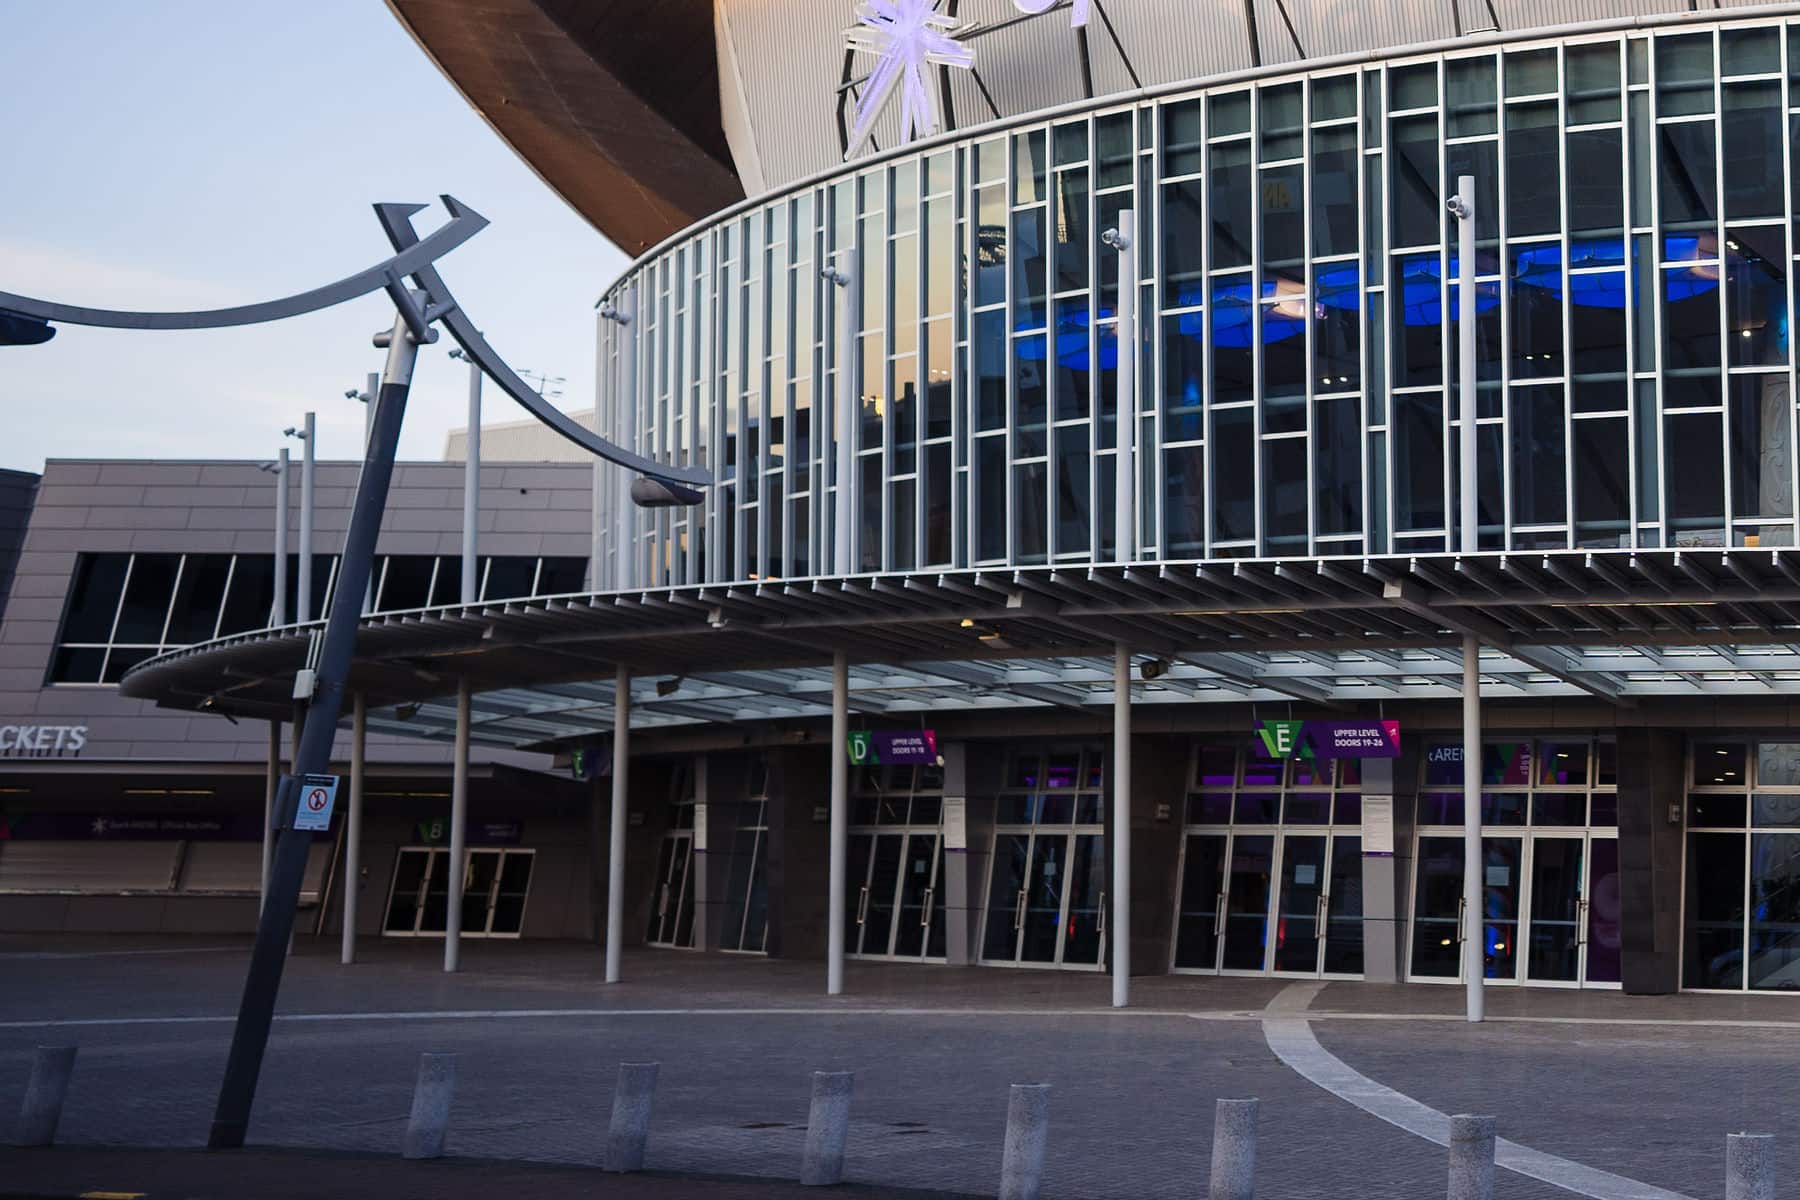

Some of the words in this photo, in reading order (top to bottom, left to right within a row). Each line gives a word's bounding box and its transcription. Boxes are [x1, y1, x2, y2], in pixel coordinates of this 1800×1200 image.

[1276, 728, 1292, 752] E
[1334, 729, 1358, 738] UPPER
[1358, 728, 1380, 737] LEVEL
[853, 739, 867, 760] D
[1335, 739, 1362, 747] DOORS
[1362, 738, 1384, 747] 19-26
